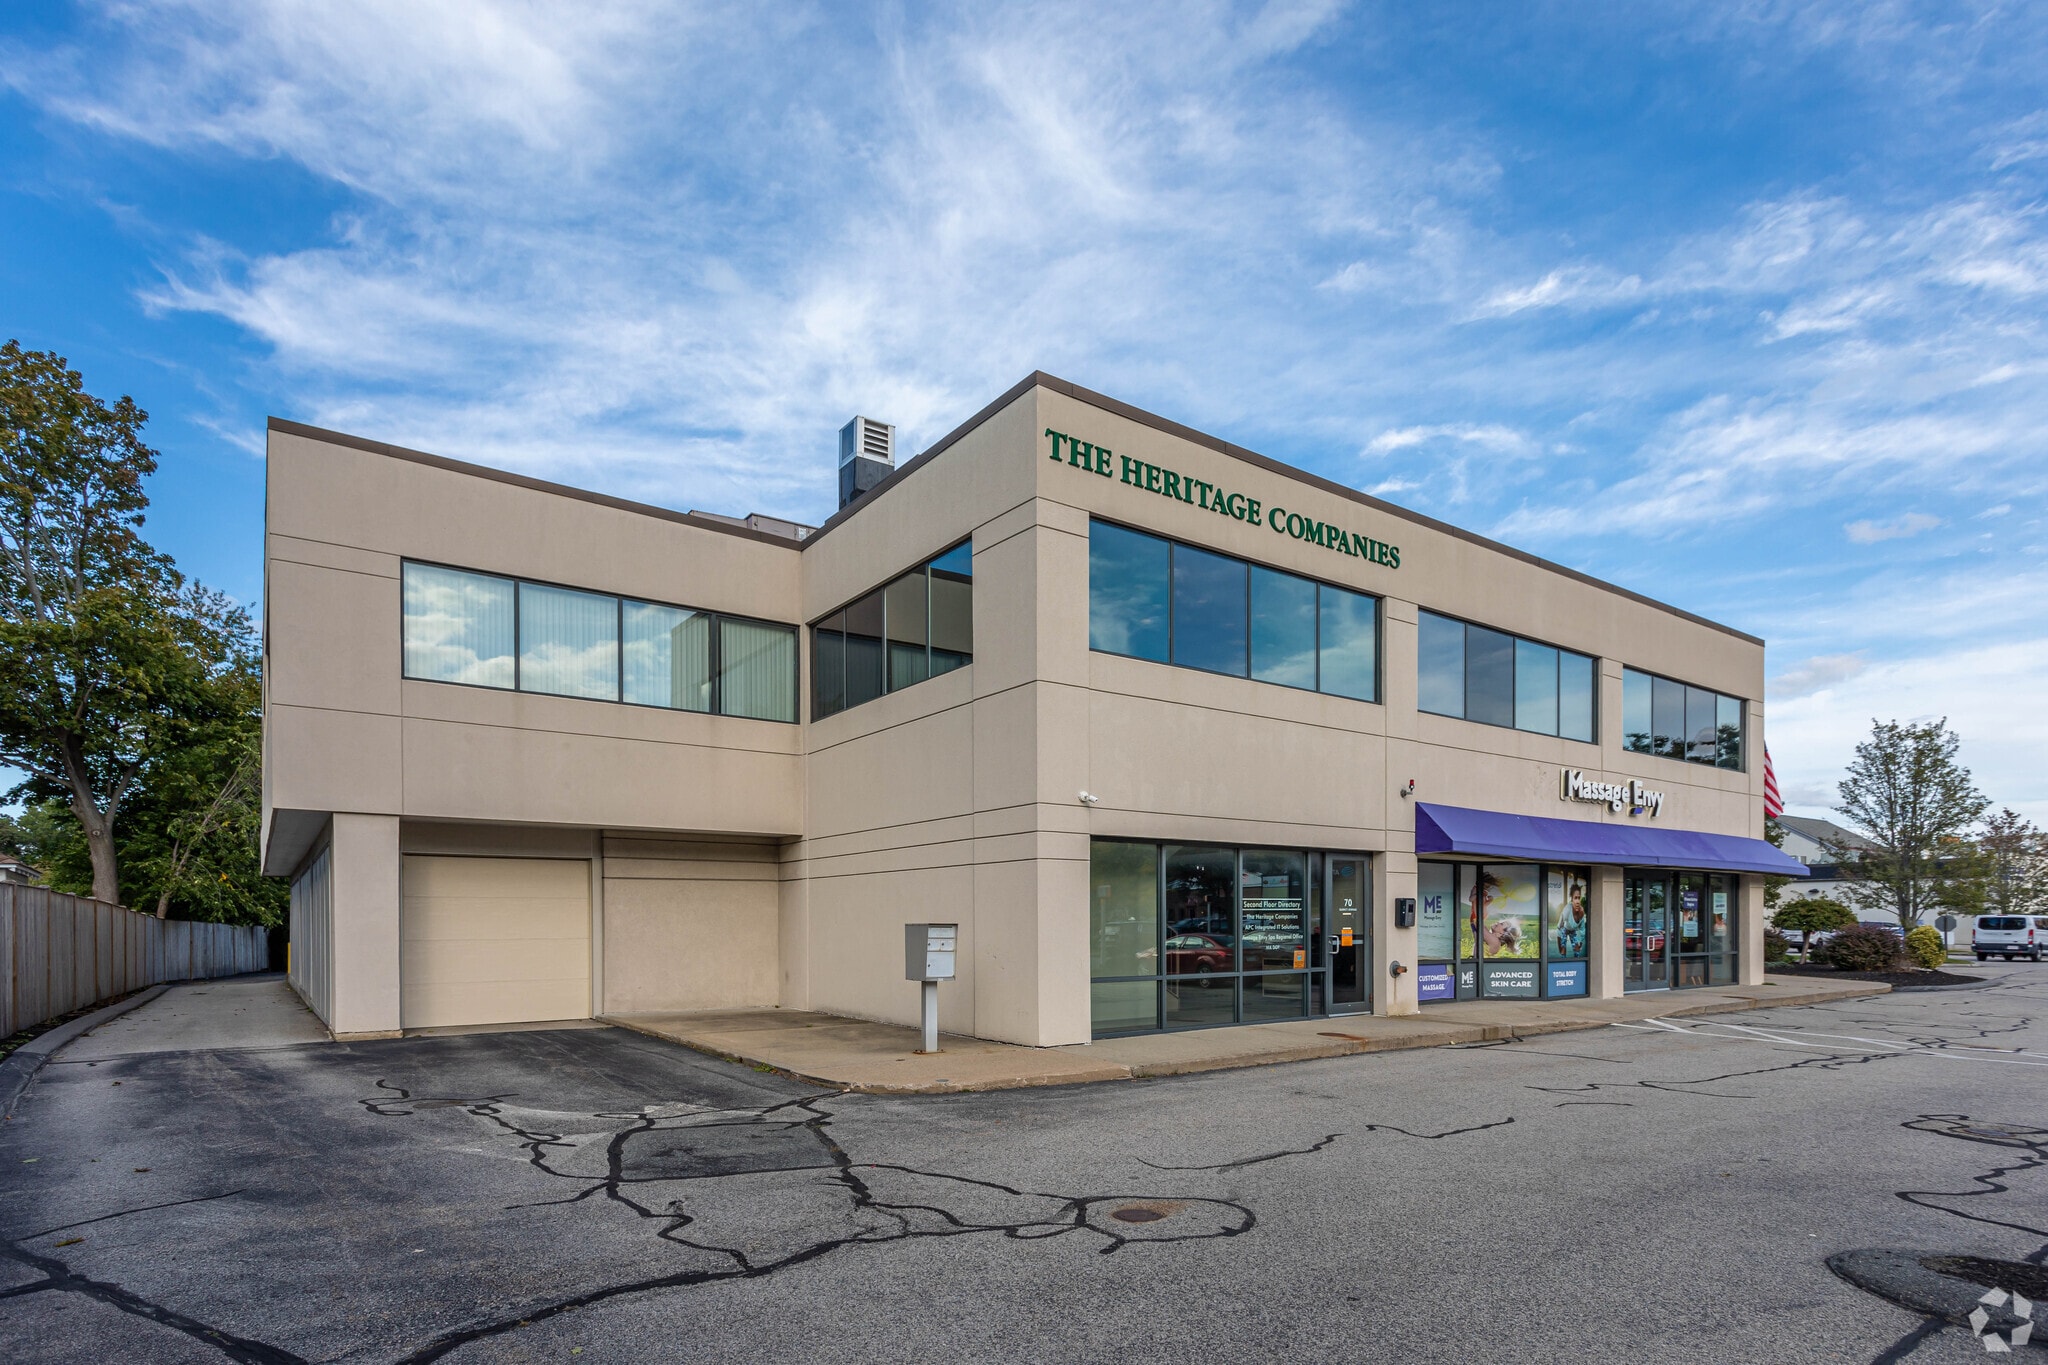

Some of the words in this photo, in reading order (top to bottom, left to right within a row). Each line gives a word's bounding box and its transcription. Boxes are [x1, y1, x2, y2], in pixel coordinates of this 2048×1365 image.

[1045, 428, 1113, 478] THE
[1120, 454, 1262, 526] HERITAGE
[1268, 506, 1401, 570] COMPANIES
[1562, 768, 1631, 813] Massage
[1629, 778, 1665, 817] Envy
[1277, 901, 1301, 909] Directory
[1344, 898, 1353, 907] 70
[1424, 895, 1442, 914] ME
[1418, 974, 1449, 982] CUSTOMIZED
[1461, 971, 1474, 985] ME
[1490, 971, 1533, 979] ADVANCED
[1422, 983, 1446, 991] MASSAGE
[1490, 980, 1509, 988] SKIN
[1510, 980, 1532, 988] CARE
[1556, 979, 1574, 987] STRETCH
